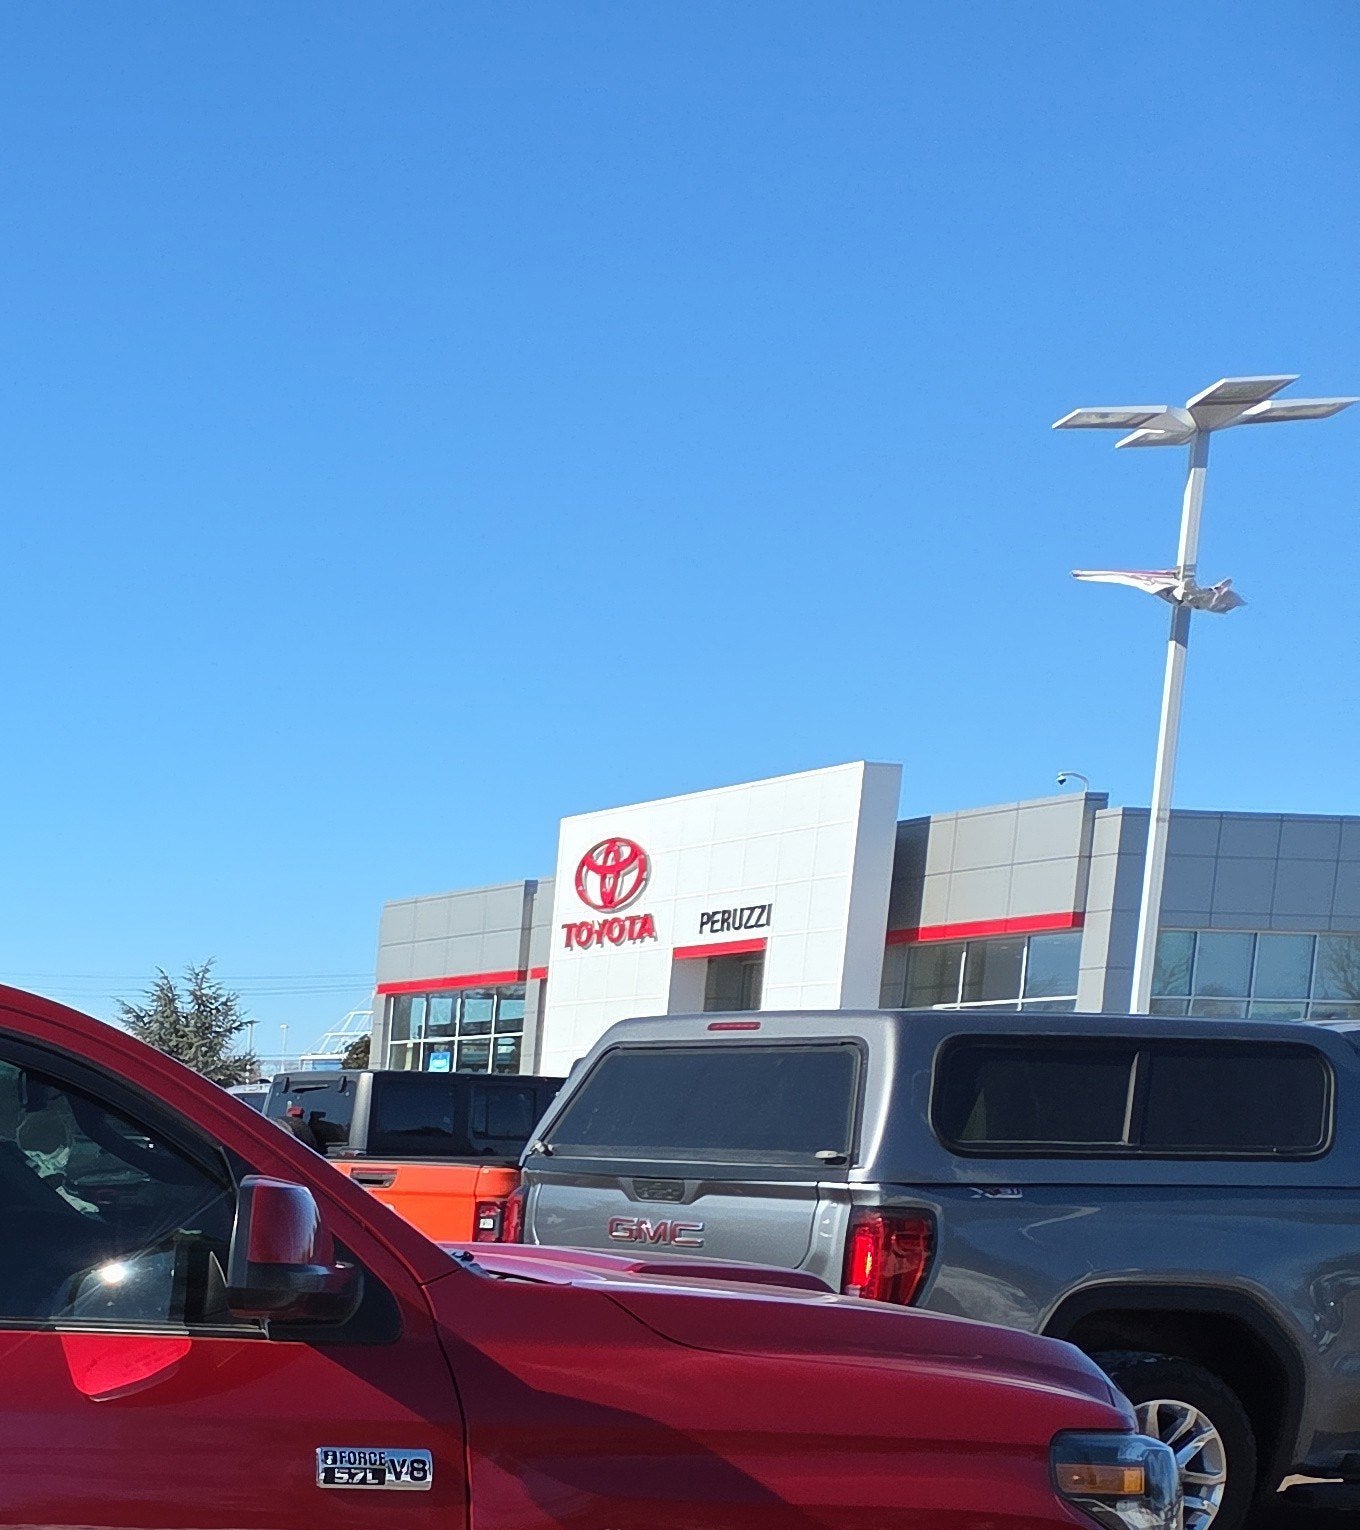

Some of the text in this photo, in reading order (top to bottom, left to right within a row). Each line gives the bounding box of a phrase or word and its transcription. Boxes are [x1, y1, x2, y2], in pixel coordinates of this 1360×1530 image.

[562, 914, 657, 949] TOYOTA
[699, 904, 772, 934] PERUZZI
[609, 1216, 705, 1248] GMC
[335, 1469, 379, 1484] 5.7L
[388, 1458, 429, 1482] V8
